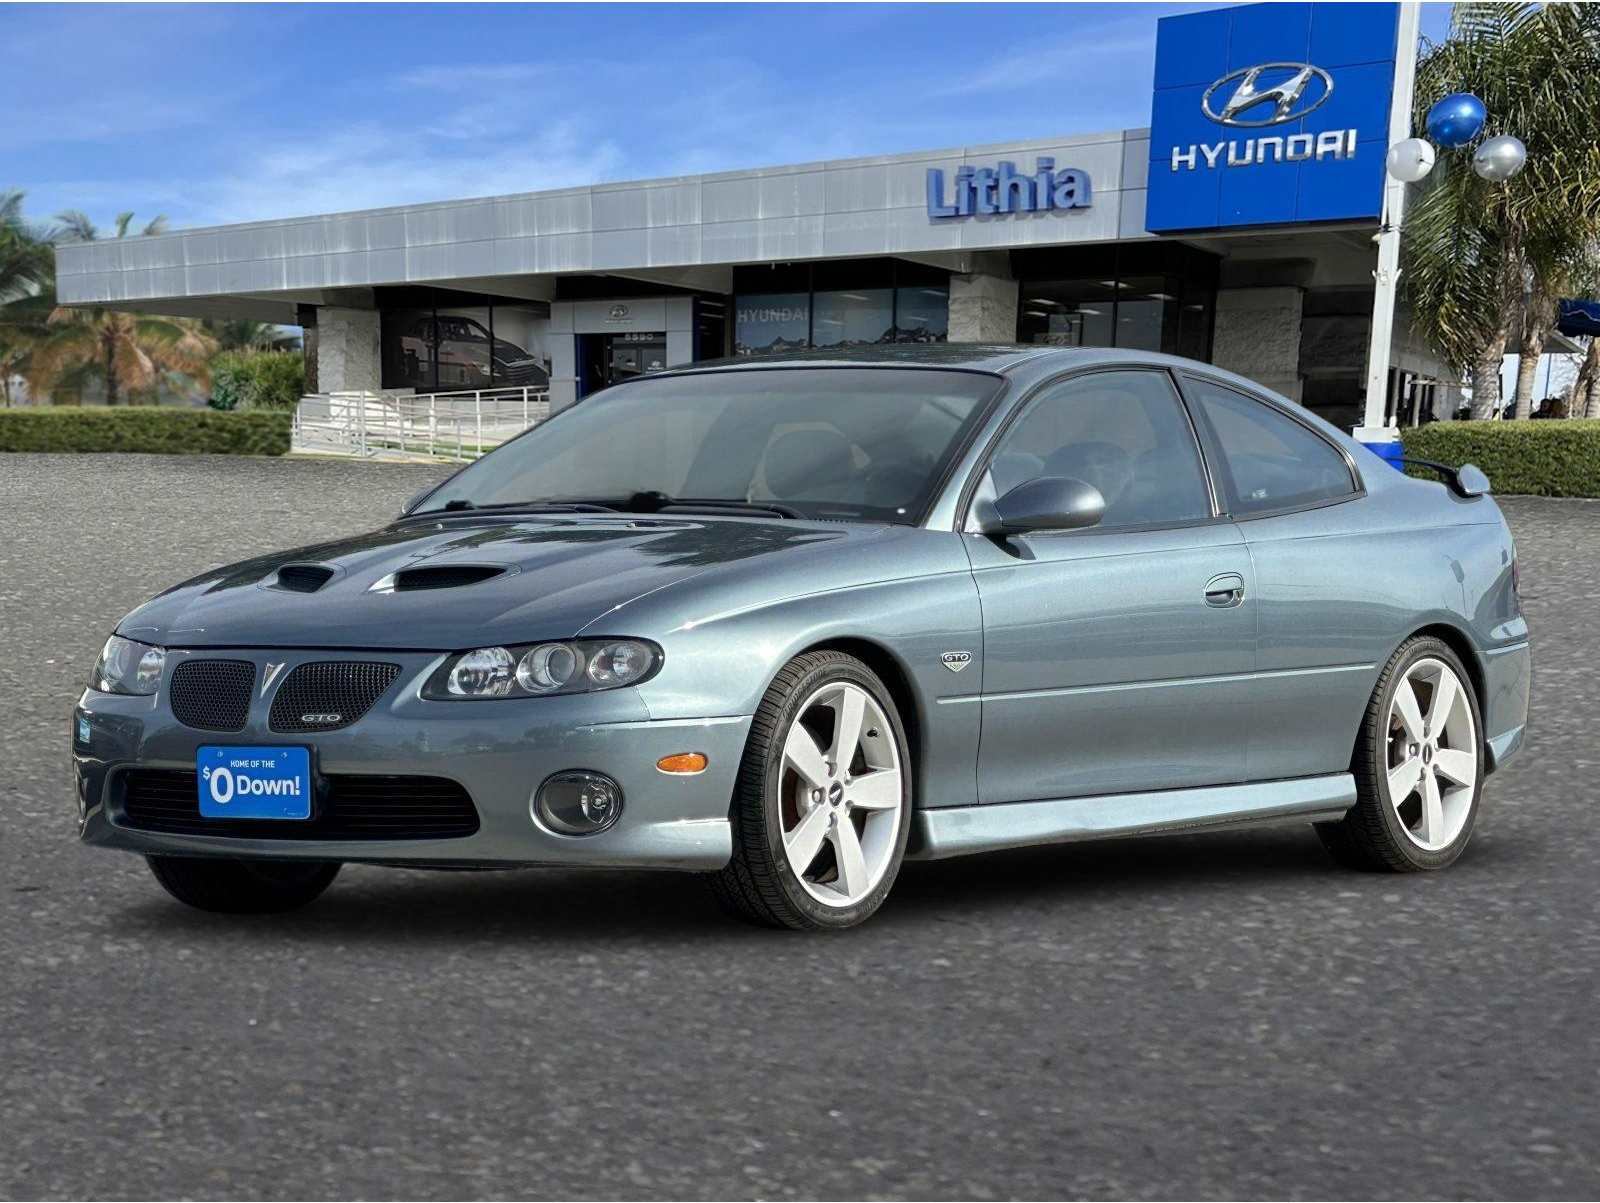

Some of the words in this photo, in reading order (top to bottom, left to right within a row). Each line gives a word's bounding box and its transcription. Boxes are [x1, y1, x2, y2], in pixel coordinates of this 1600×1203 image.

[1171, 129, 1357, 173] HYUNDAI
[927, 157, 1093, 219] Lithia
[737, 307, 808, 324] HYUNDAI
[944, 653, 969, 662] GTO
[301, 713, 341, 722] GTO
[230, 760, 249, 768] HOME
[250, 760, 260, 768] OF
[261, 760, 275, 768] THE
[236, 775, 301, 795] Down!
